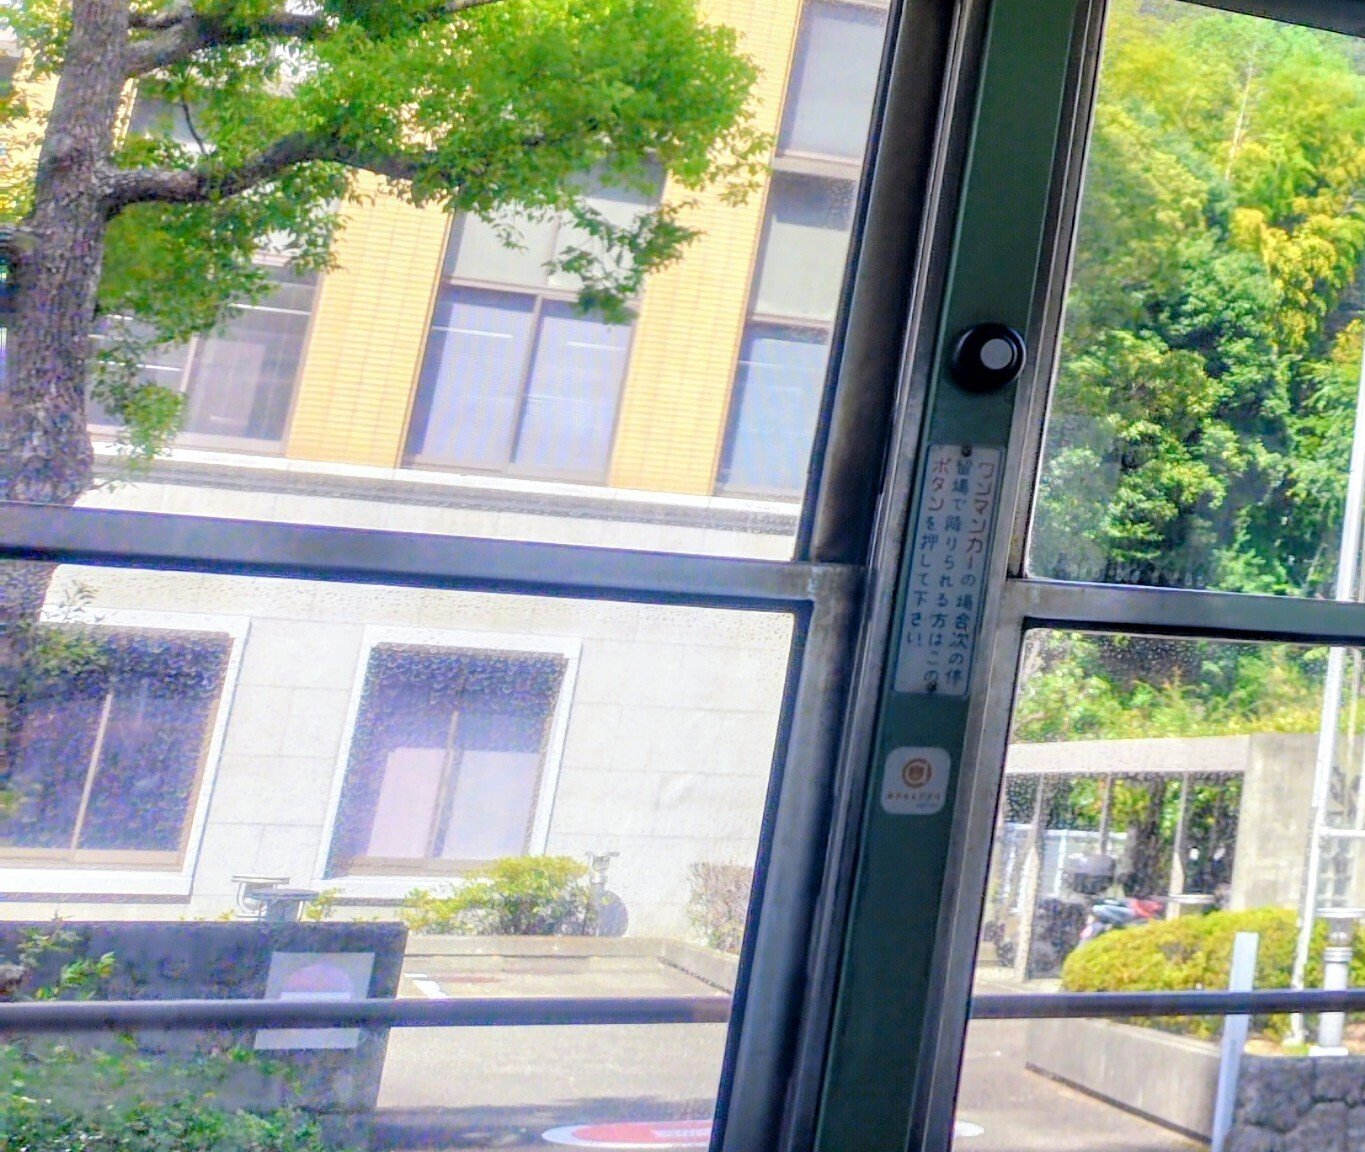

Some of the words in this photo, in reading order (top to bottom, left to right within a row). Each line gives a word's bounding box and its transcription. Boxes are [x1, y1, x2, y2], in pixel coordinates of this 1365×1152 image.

[907, 457, 952, 647] ボタンを押して下さい
[946, 461, 995, 685] ワンマンカーの場合次の停
